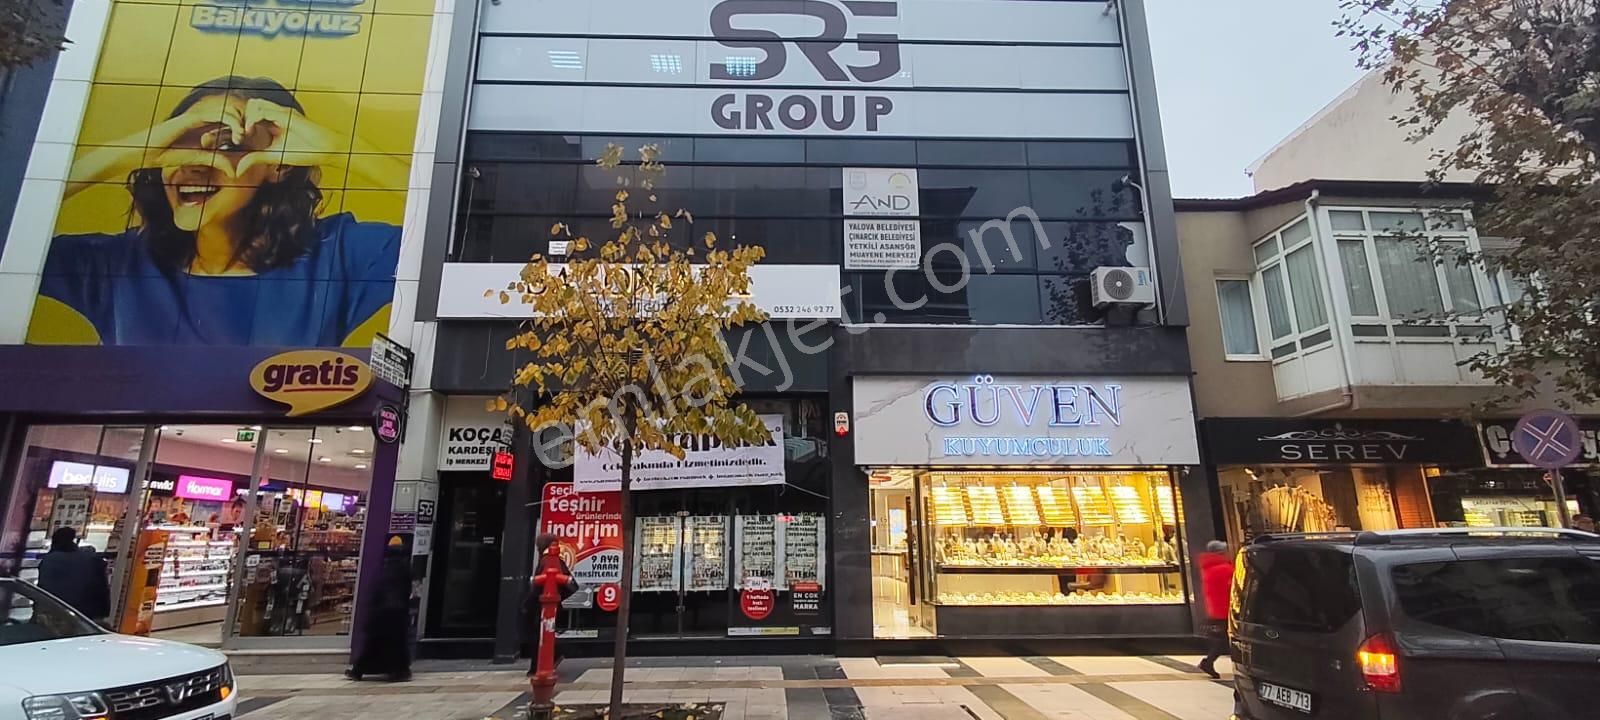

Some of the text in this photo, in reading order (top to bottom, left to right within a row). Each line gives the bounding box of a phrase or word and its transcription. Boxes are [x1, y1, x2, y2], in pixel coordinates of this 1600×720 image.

[191, 5, 362, 37] Bakıyoruz
[710, 0, 901, 82] SRG
[711, 94, 893, 131] GROUP
[849, 222, 916, 231] YALOVA BELEDİYESİ
[849, 231, 916, 242] ÇINARCIK BELEDİYESİ
[849, 242, 878, 250] YETKİLİ
[885, 250, 917, 258] MERKEZİ
[774, 305, 794, 313] 0532
[263, 357, 360, 392] gratis
[924, 374, 1122, 427] GÜVEN
[449, 427, 505, 445] KOÇA
[943, 436, 1113, 457] KUYUMCULUK
[1280, 444, 1407, 460] SEREV
[446, 457, 488, 466] İŞ MERKEZİ
[629, 461, 675, 471] akında
[549, 496, 606, 516] teşhir
[547, 520, 619, 539] indirim
[591, 555, 619, 564] 9 AYA
[604, 586, 616, 602] 9
[1262, 683, 1272, 698] 77
[1276, 687, 1292, 703] AEB
[1295, 691, 1310, 708] 713
